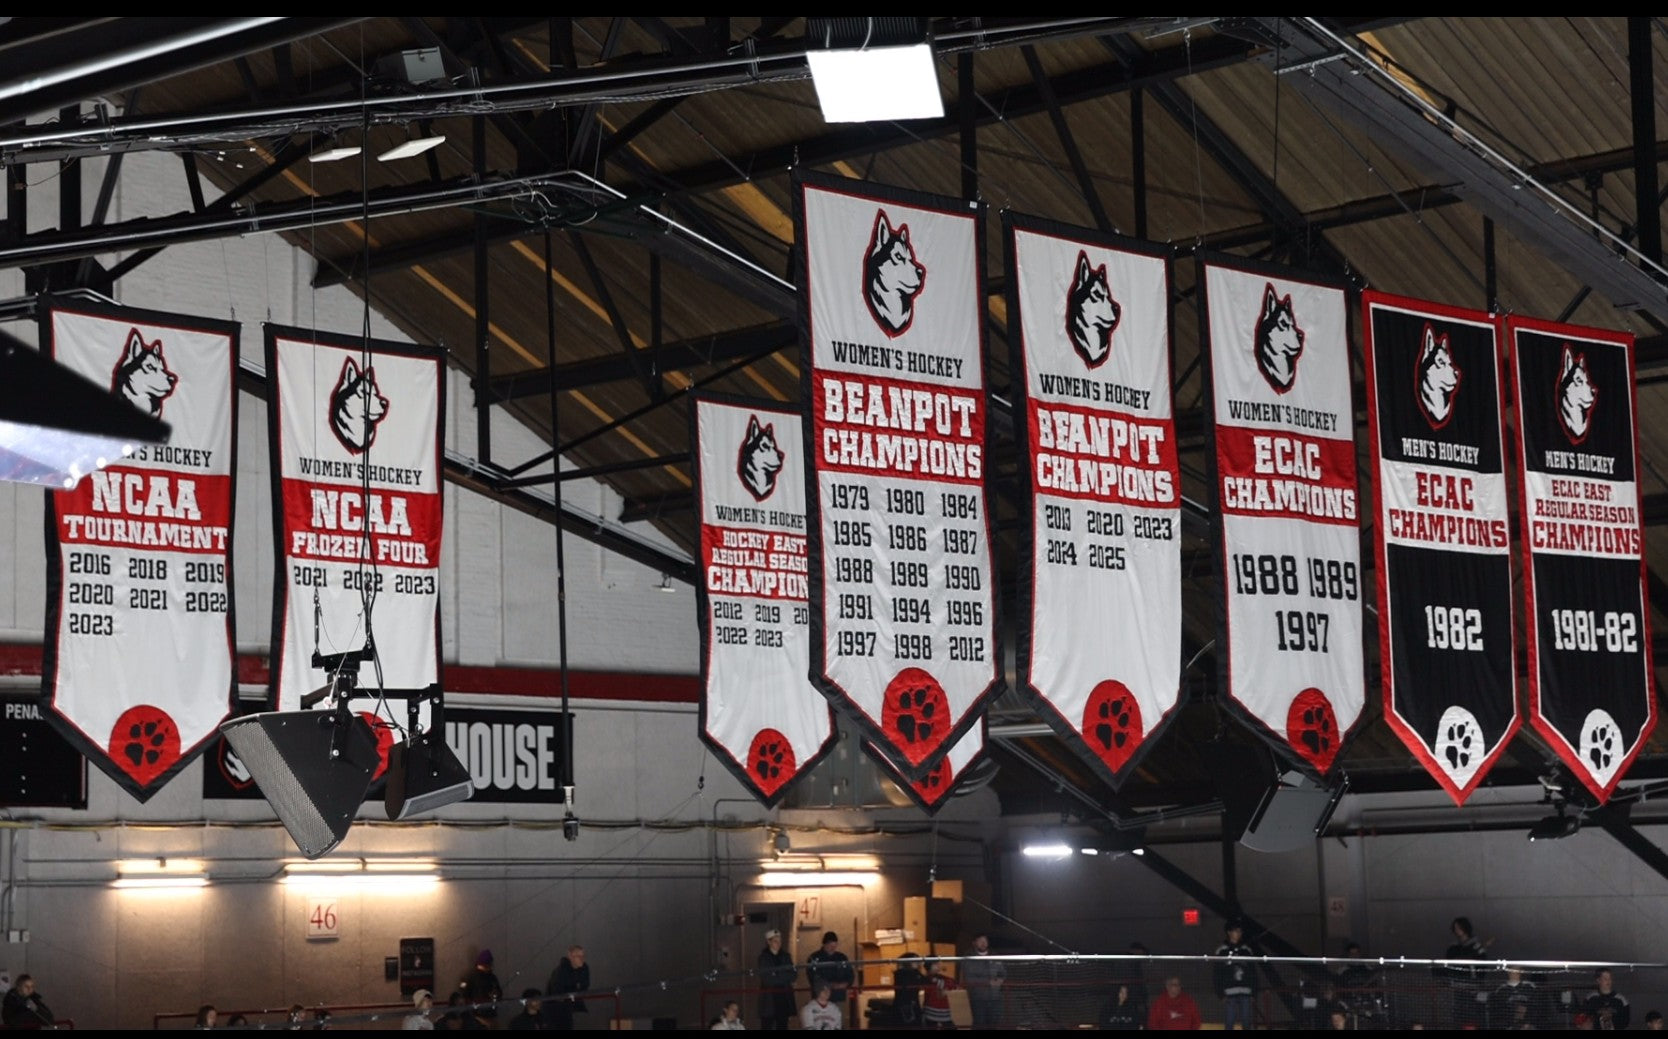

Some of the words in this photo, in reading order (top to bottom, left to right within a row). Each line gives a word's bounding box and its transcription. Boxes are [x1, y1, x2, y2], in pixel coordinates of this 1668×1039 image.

[832, 340, 903, 370] WOMEN'S
[908, 351, 963, 378] HOCKEY
[823, 378, 976, 438] BEANPOT
[1040, 374, 1100, 401] WOMEN'S
[1105, 383, 1150, 410] HOCKEY
[1228, 400, 1292, 424] WOMEN'S
[1293, 407, 1337, 432] HOCKEY
[823, 428, 982, 478] CHAMPIONS
[1037, 408, 1164, 464] BEANPOT
[1402, 438, 1436, 459] MEN'S
[1438, 442, 1480, 465] HOCKEY
[154, 446, 212, 468] HOCKEY
[299, 457, 364, 480] WOMEN'S
[369, 465, 422, 486] HOCKEY
[1254, 436, 1322, 480] ECAC
[1545, 450, 1576, 470] MEN'S
[1578, 453, 1615, 475] HOCKEY
[91, 471, 202, 520] NCAA
[1036, 454, 1174, 503] CHAMPIONS
[1416, 472, 1474, 512] ECAC
[1552, 480, 1580, 498] ECAC
[1584, 482, 1612, 502] EAST
[310, 488, 412, 536] NCAA
[832, 484, 869, 510] 1979
[886, 488, 924, 516] 1980
[941, 493, 977, 520] 1984
[1224, 476, 1356, 520] CHAMPIONS
[1536, 498, 1588, 520] REGULAR
[1589, 504, 1635, 524] SEASON
[63, 514, 228, 550] TOURNAMENT
[716, 505, 766, 524] WOMEN'S
[770, 511, 807, 529] HOCKE
[1045, 504, 1071, 531] 2013
[1087, 510, 1124, 536] 2020
[1134, 516, 1172, 541] 2023
[1389, 508, 1508, 548] CHAMPIONS
[292, 531, 370, 560] FROZEN
[377, 539, 430, 565] FOUR
[723, 530, 770, 550] HOCKEY
[774, 535, 806, 554] EAST
[834, 520, 872, 547] 1985
[888, 524, 927, 551] 1986
[942, 528, 977, 554] 1987
[1533, 520, 1640, 554] CHAMPIONS
[70, 552, 111, 575] 2016
[129, 558, 167, 580] 2018
[186, 562, 224, 584] 2019
[712, 548, 767, 568] REGULAR
[836, 557, 873, 584] 1988
[890, 561, 928, 588] 1989
[944, 564, 980, 590] 1990
[1089, 544, 1126, 570] 2025
[294, 566, 328, 587] 2021
[344, 570, 384, 592] 2022
[395, 574, 435, 595] 2023
[1233, 554, 1299, 595] 1988
[1307, 557, 1358, 600] 1989
[70, 583, 114, 606] 2020
[130, 588, 168, 610] 2021
[186, 592, 227, 612] 2022
[714, 602, 742, 620] 2012
[755, 604, 780, 624] 2019
[839, 594, 874, 620] 1991
[892, 598, 931, 624] 1994
[947, 600, 982, 626] 1996
[70, 614, 114, 636] 2023
[716, 626, 748, 645] 2022
[755, 628, 783, 648] 2023
[1276, 610, 1329, 654] 1997
[1424, 605, 1484, 651] 1982
[1552, 608, 1638, 653] 1981-82
[838, 631, 876, 657] 1997
[894, 634, 932, 660] 1998
[949, 636, 984, 662] 2012
[445, 722, 555, 790] HOUSE
[310, 904, 336, 930] 46
[800, 897, 818, 919] 47
